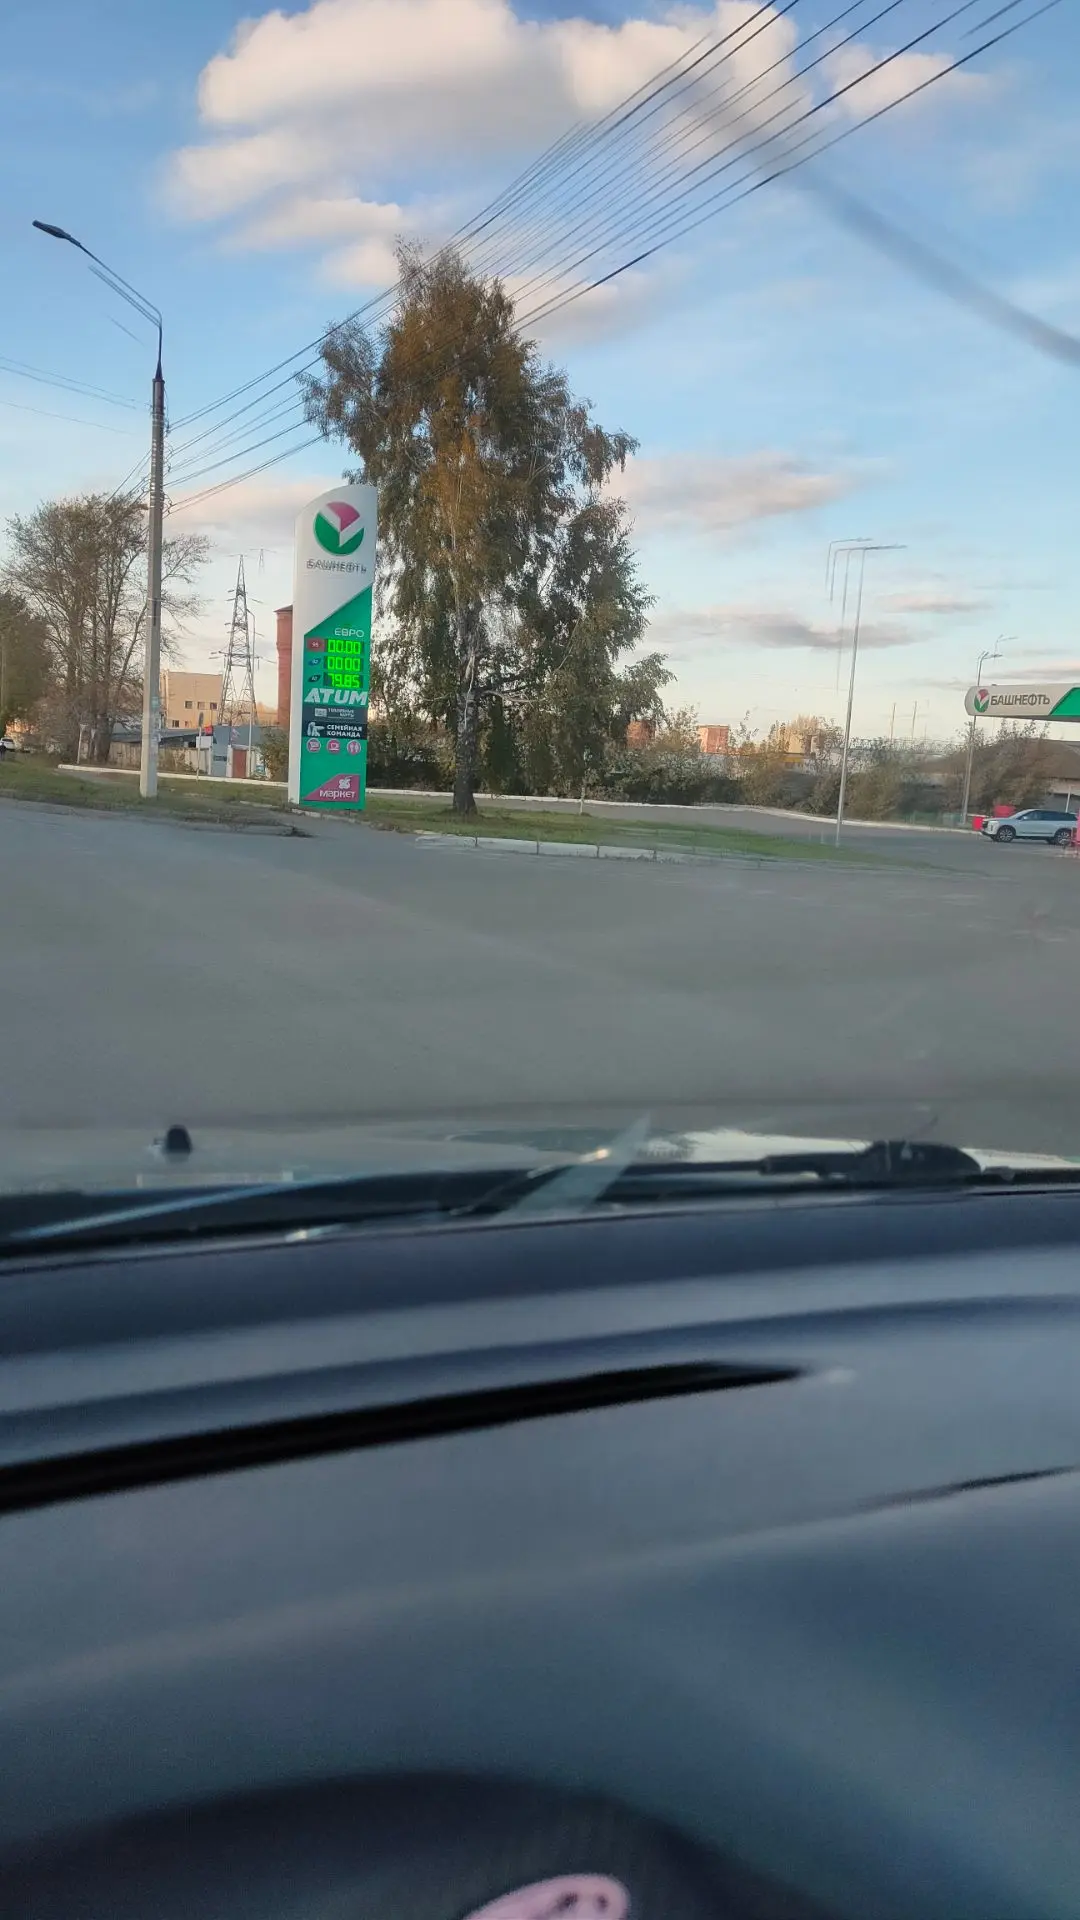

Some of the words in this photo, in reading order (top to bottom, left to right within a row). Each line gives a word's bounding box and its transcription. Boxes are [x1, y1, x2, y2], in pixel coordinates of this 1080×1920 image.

[306, 559, 367, 573] БАШНЕФТЬ
[334, 628, 365, 638] ЕВРО
[304, 687, 368, 706] ATUM
[990, 694, 1050, 706] БАШНЕФТЬ
[326, 724, 362, 732] СЕМЕЙНАЯ
[326, 730, 361, 738] КОМАНДА
[319, 790, 355, 799] маркет
